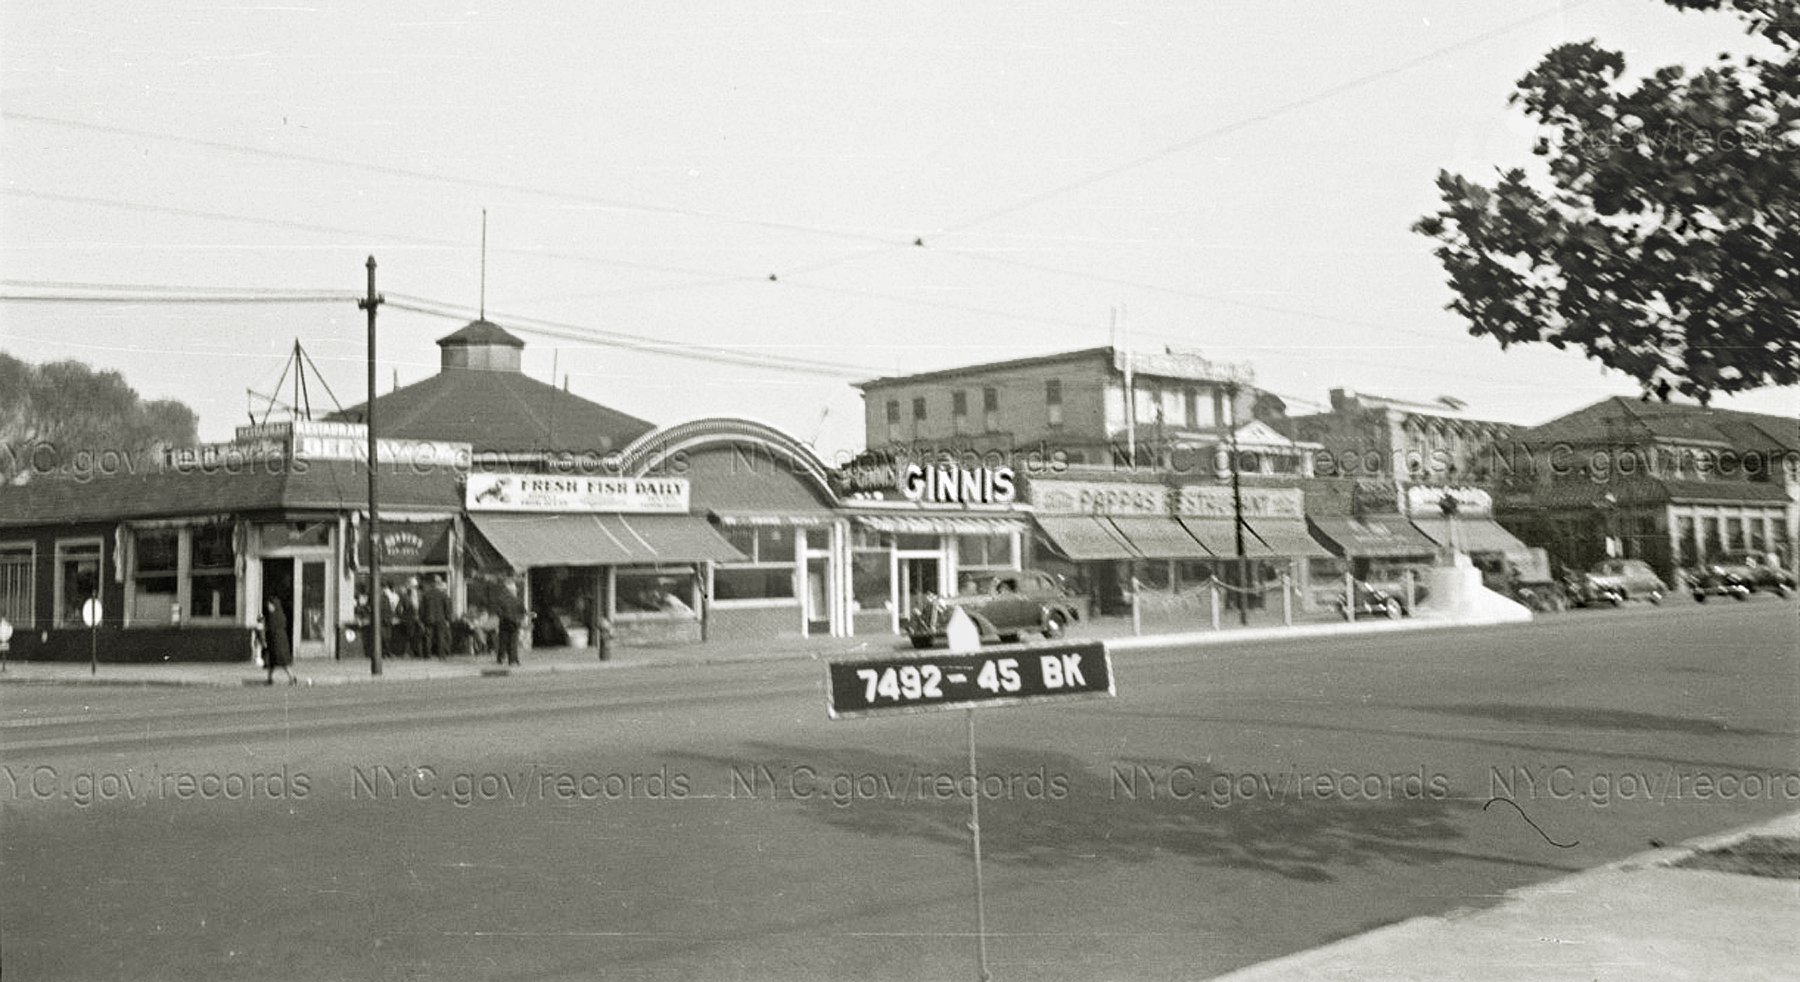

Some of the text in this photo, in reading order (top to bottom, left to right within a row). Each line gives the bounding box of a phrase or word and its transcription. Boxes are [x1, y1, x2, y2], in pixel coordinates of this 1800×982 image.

[521, 479, 682, 496] FRESH FISH DAILY
[1079, 488, 1155, 514] PAPPAS
[1039, 652, 1087, 688] BK
